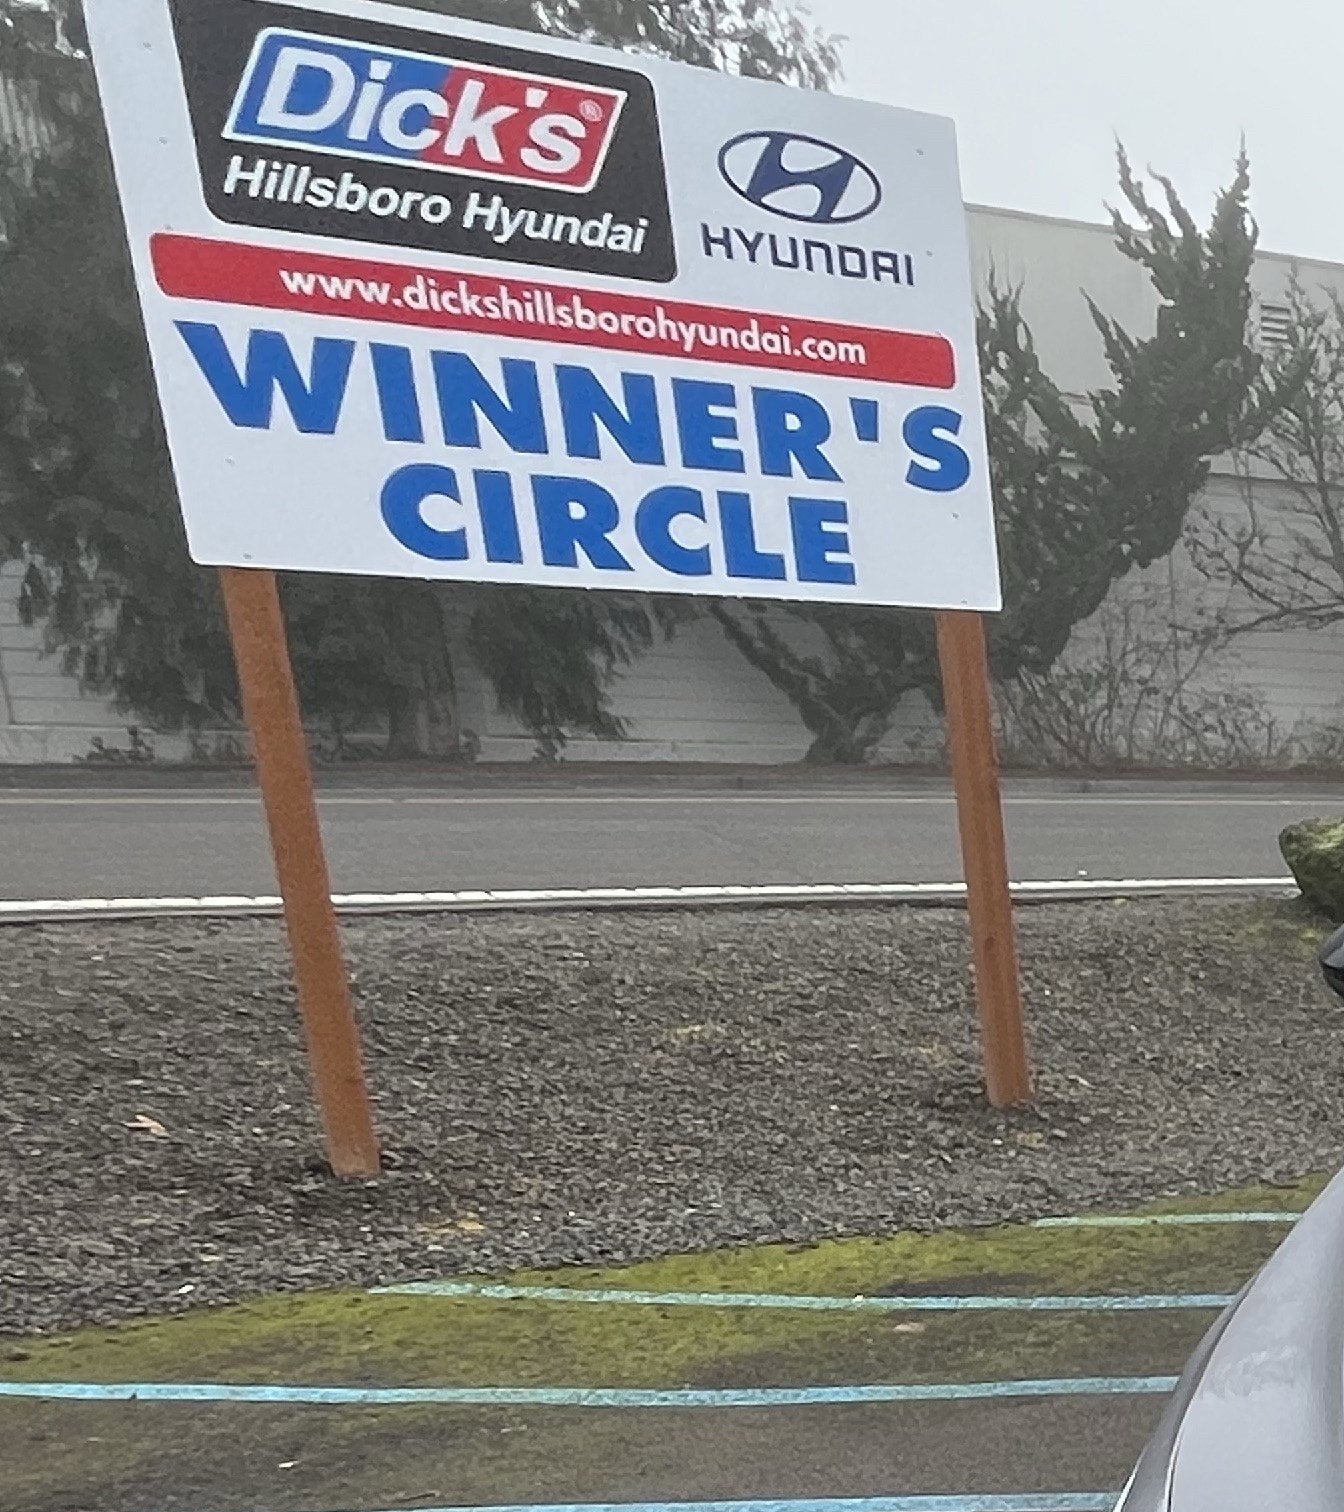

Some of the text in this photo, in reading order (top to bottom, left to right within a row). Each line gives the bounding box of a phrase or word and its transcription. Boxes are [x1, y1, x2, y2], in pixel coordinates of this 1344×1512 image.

[223, 155, 648, 254] Hillsboro Hyundai
[700, 222, 916, 287] HYUNDAI
[280, 264, 867, 367] www.dickshillsborohyundai.com
[174, 319, 973, 493] WINNER'S
[379, 463, 856, 585] CIRCLE
